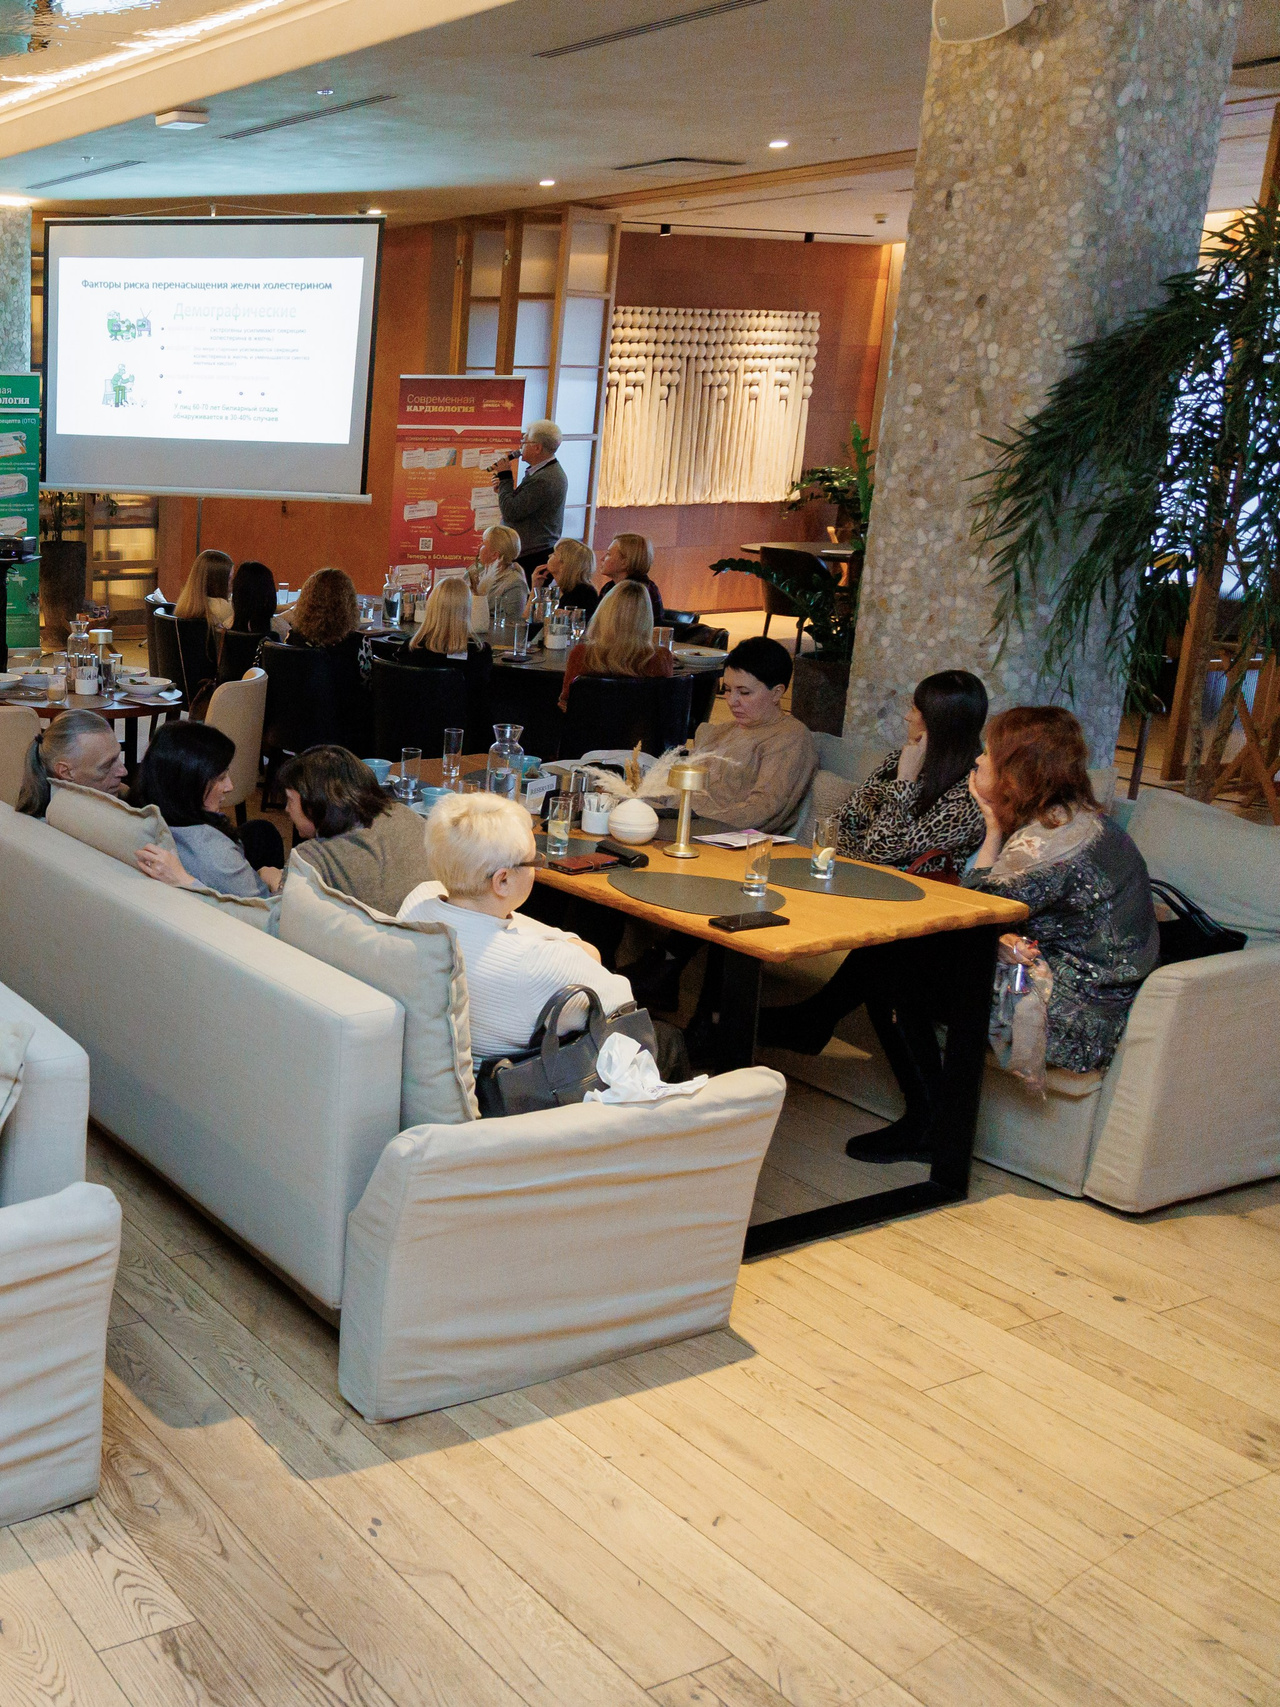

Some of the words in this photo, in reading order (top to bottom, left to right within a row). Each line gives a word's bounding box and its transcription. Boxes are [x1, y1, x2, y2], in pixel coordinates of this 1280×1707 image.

[81, 279, 122, 291] Факторы
[123, 281, 150, 291] риска
[152, 281, 228, 291] перенасыщения
[230, 281, 261, 291] желчи
[262, 281, 333, 292] холестерином
[173, 302, 297, 321] Демографические
[406, 393, 476, 405] Современная
[192, 403, 209, 411] 60-70
[221, 404, 258, 413] билиарный
[406, 405, 476, 413] КАРДИОЛОГИЯ
[173, 412, 224, 422] обнаруживается
[229, 414, 252, 422] 30-40%
